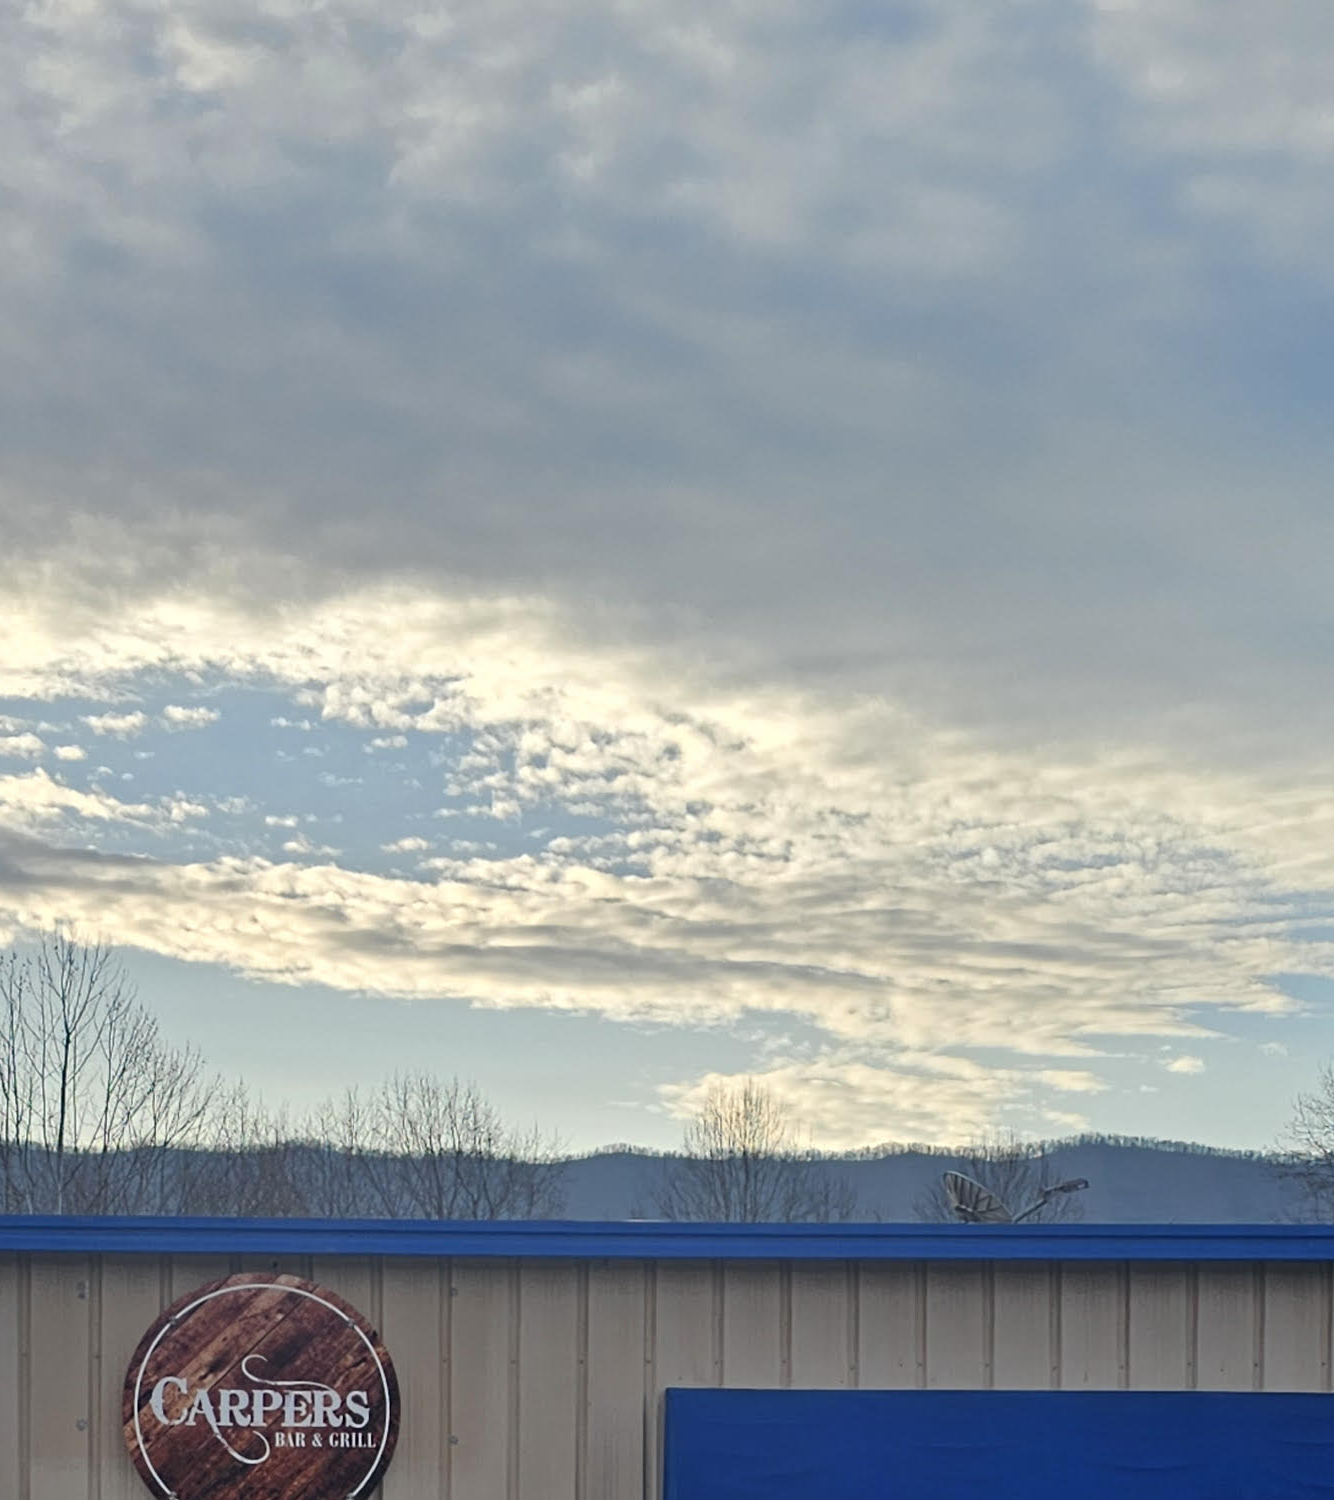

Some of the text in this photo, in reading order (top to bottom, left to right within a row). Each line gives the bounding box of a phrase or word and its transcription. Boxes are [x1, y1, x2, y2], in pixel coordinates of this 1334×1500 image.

[149, 1372, 371, 1435] CARPERS
[274, 1431, 377, 1448] BAR & GRILL
